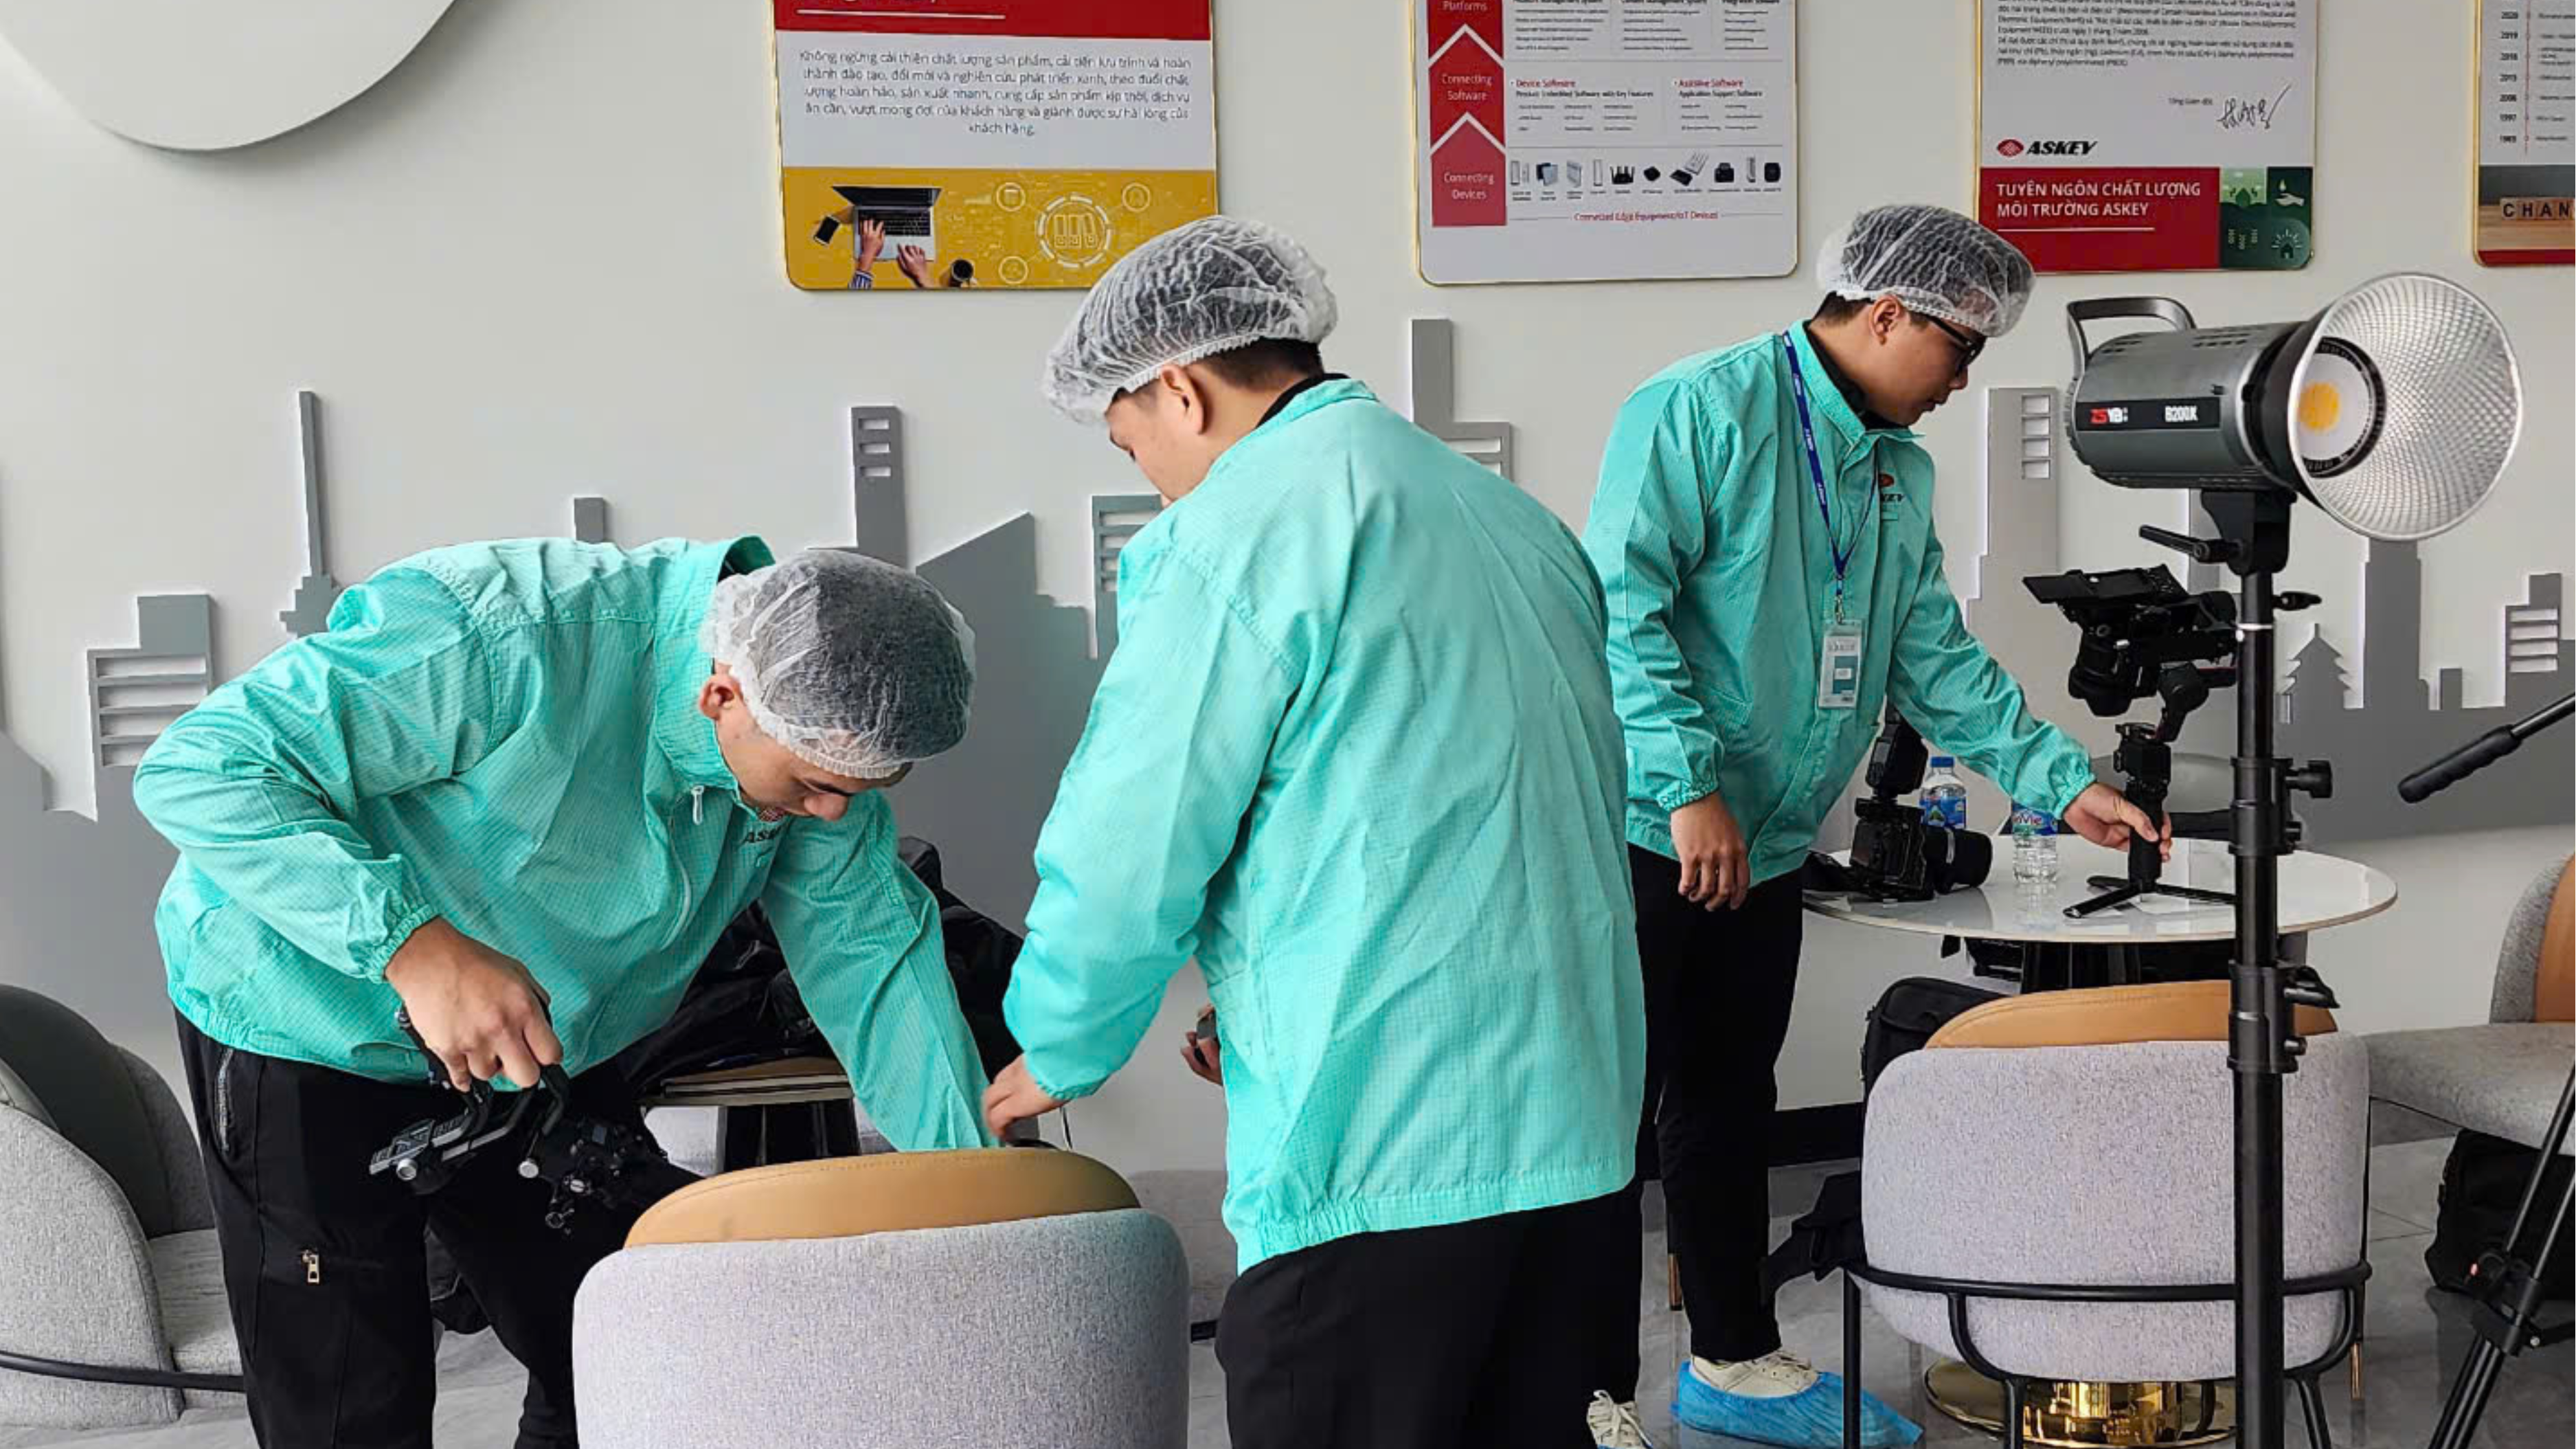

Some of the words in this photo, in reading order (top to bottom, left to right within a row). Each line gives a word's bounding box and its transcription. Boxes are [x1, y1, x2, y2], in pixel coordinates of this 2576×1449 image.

[1442, 74, 1493, 87] Connecting
[1516, 79, 1540, 88] Device
[1543, 78, 1576, 88] Software
[1711, 78, 1743, 88] Software
[1447, 90, 1488, 101] Software
[2026, 141, 2098, 156] ASKEY
[1443, 172, 1495, 186] Connecting
[1451, 189, 1487, 201] Devices
[1997, 180, 2046, 196] TUYÊN
[2051, 179, 2098, 196] NGÔN
[2102, 179, 2141, 196] CHẤT
[2145, 181, 2201, 199] LƯỢNG
[1997, 200, 2027, 218] MÔI
[2033, 199, 2099, 217] TRƯỜNG
[2102, 203, 2149, 216] ASKEY
